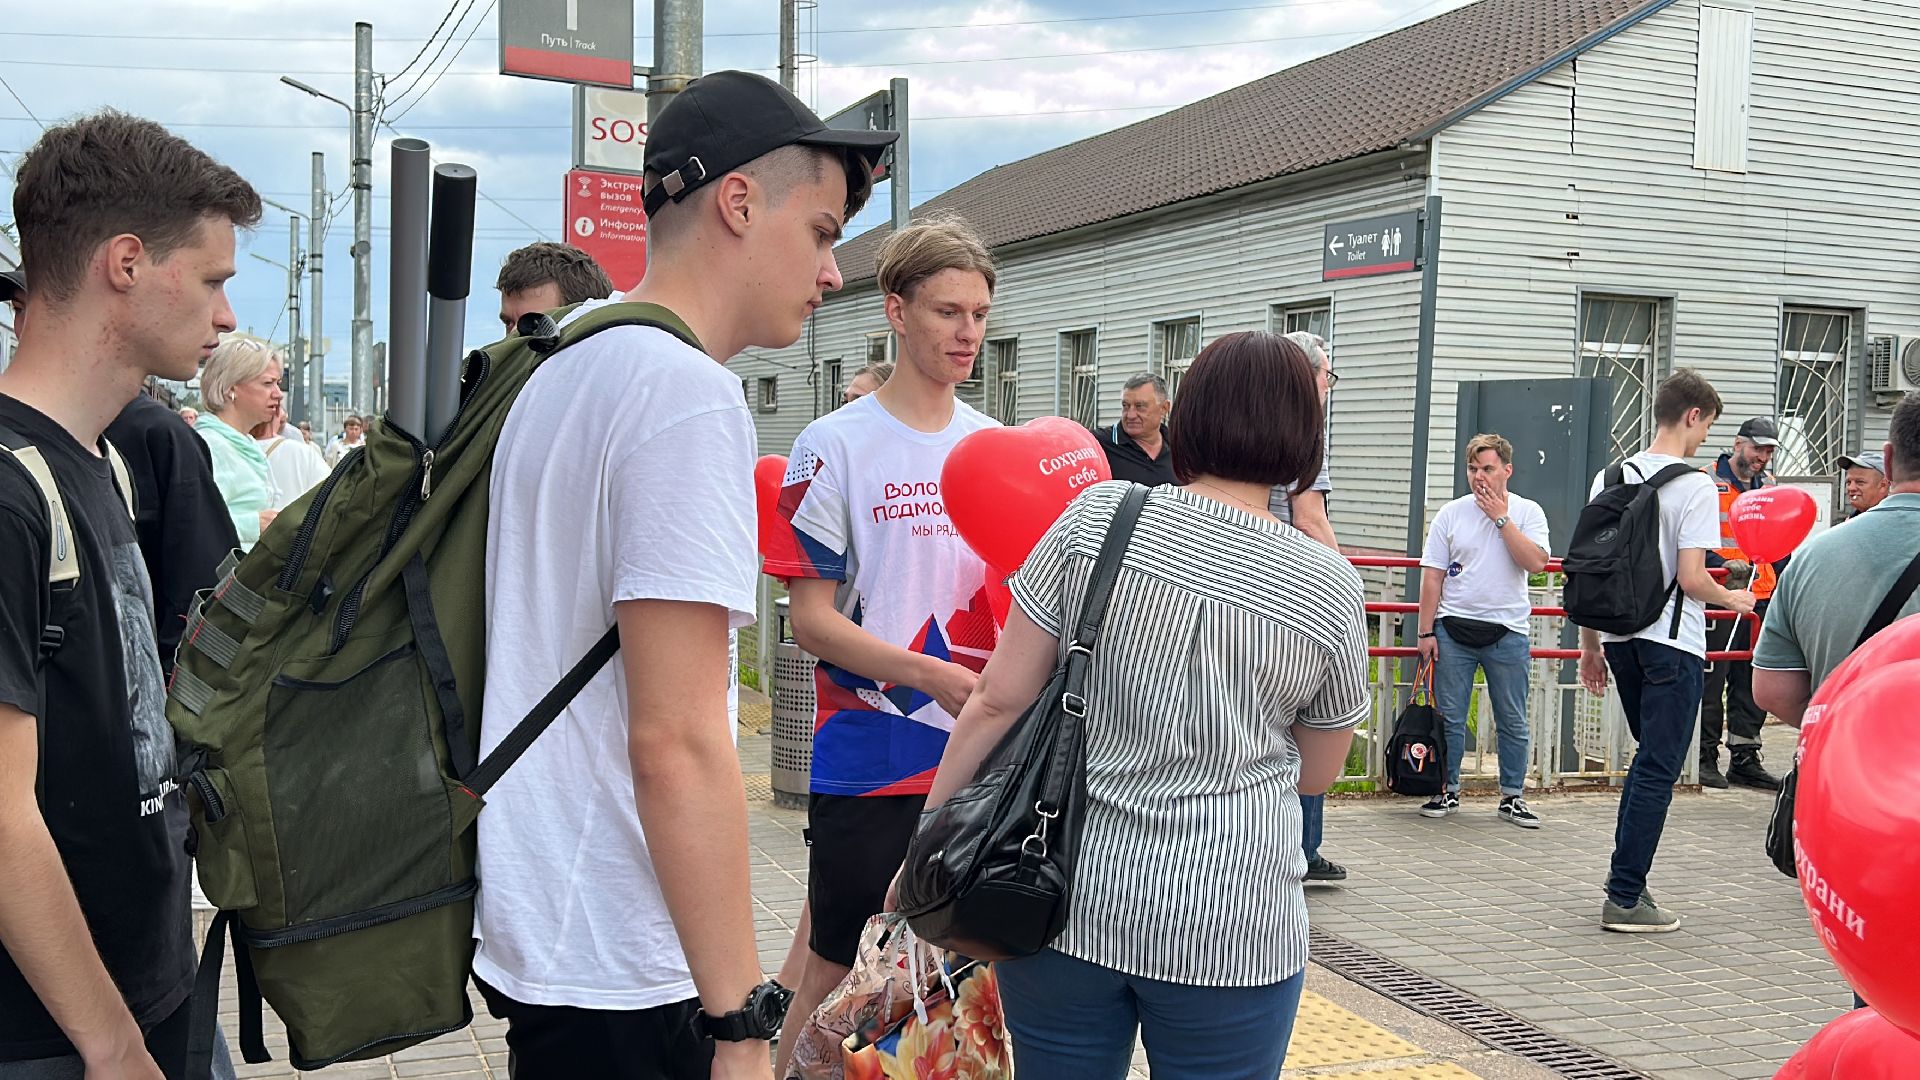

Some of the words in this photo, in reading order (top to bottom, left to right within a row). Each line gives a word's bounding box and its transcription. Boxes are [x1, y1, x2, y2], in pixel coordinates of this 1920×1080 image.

[541, 33, 568, 48] Путь
[575, 40, 597, 51] Track
[600, 192, 632, 202] вызов
[600, 204, 643, 215] Emergency
[600, 232, 646, 242] Information
[1347, 233, 1378, 248] Туалет
[1347, 250, 1366, 261] Toilet
[1039, 447, 1099, 476] Сохрани
[1068, 466, 1098, 488] себе
[884, 482, 941, 500] Воло
[912, 525, 933, 536] МЫ
